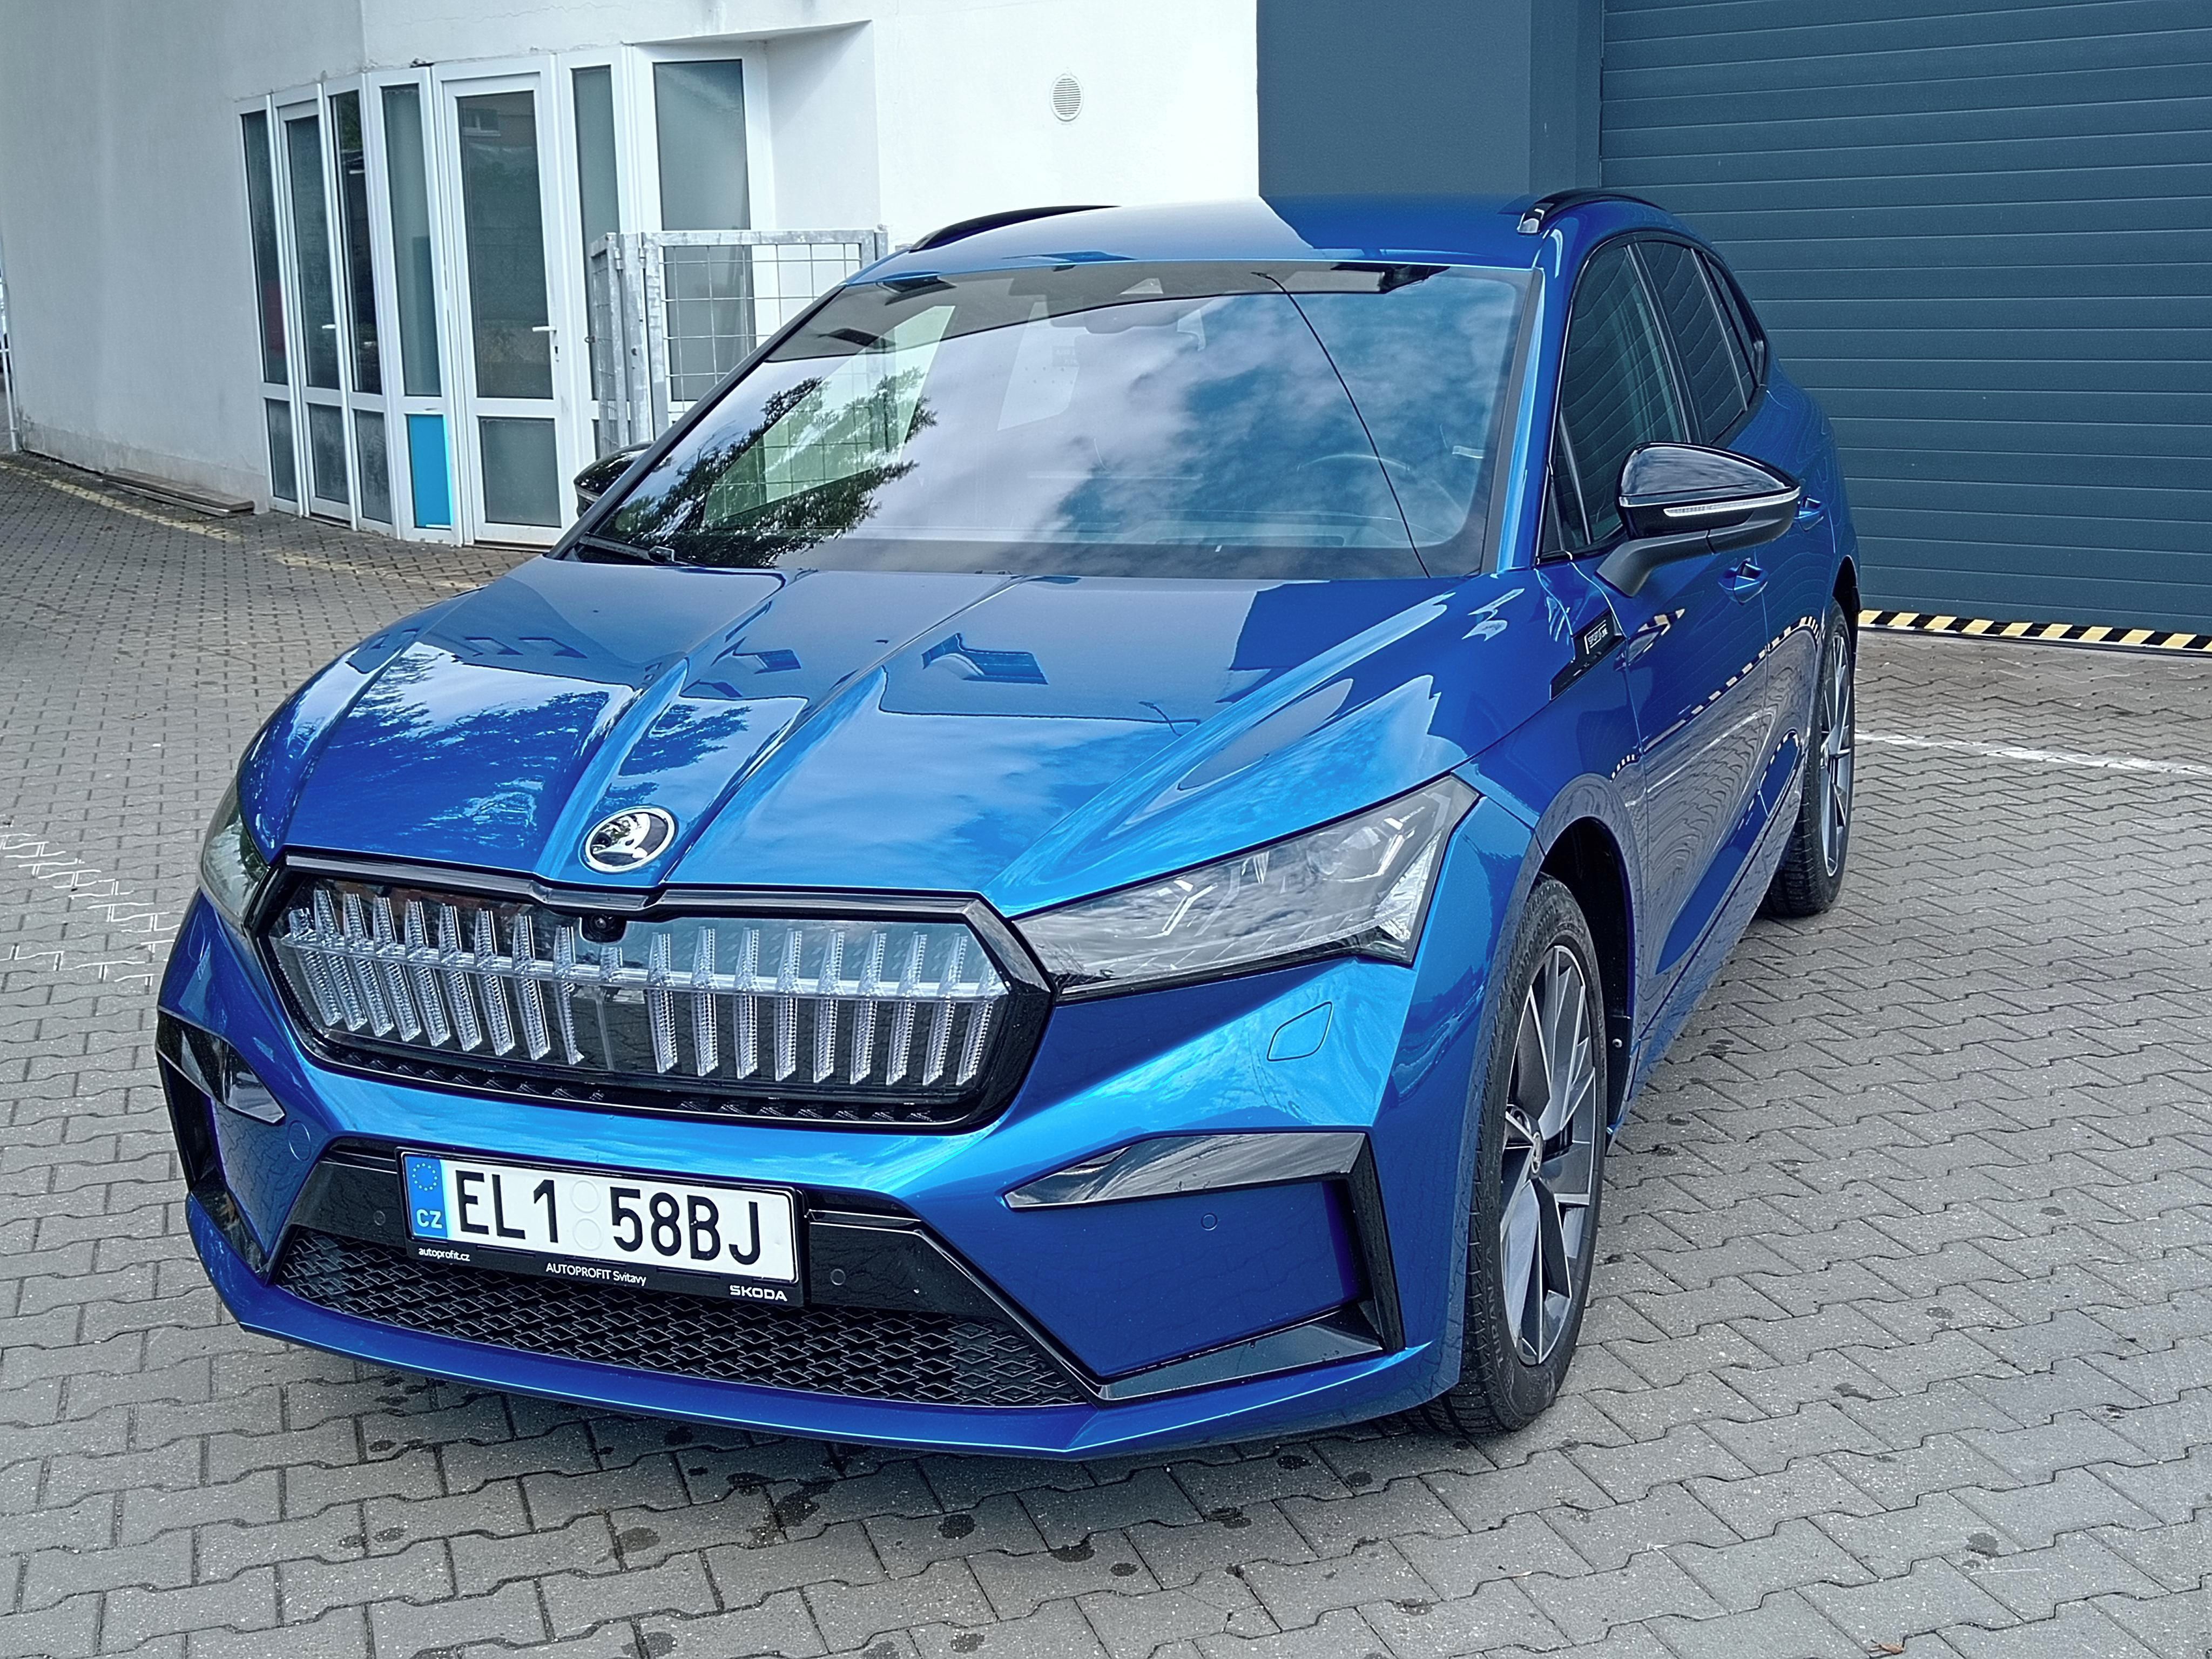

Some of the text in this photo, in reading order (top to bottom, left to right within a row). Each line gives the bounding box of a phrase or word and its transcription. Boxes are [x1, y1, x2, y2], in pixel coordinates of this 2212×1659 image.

[416, 1209, 443, 1229] CZ
[418, 1247, 471, 1262] autoprofit.cz
[545, 1263, 646, 1286] AUTOPROFIT Svitavy
